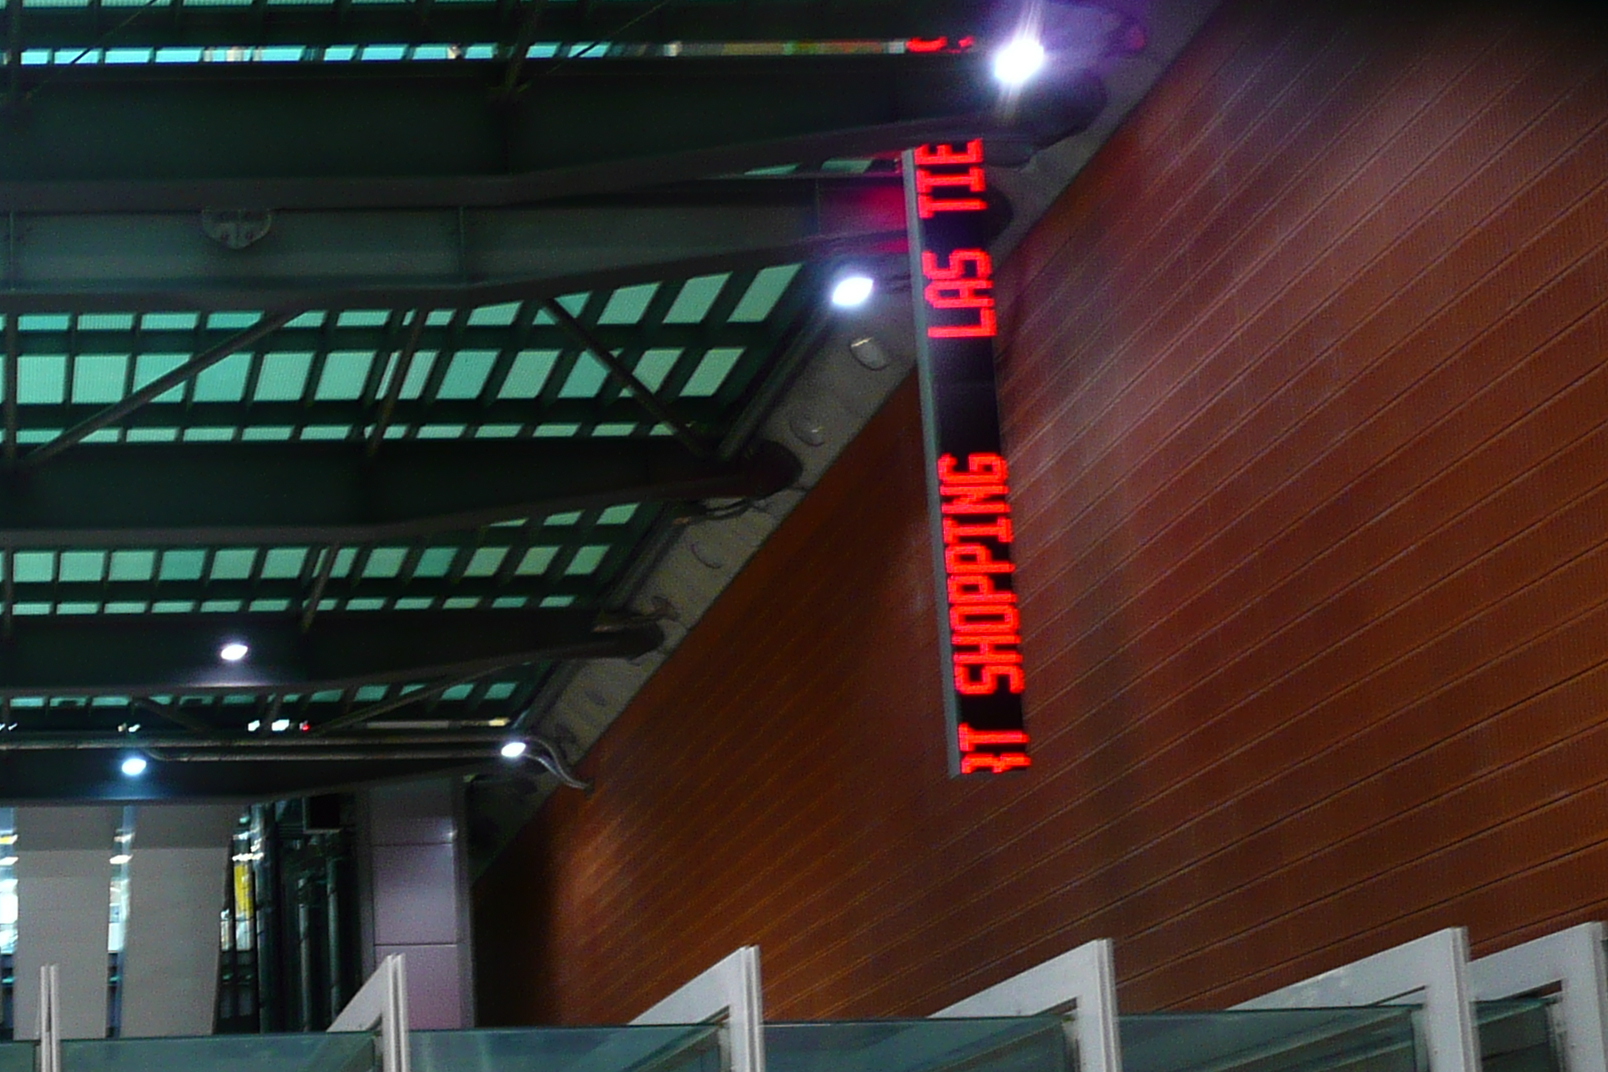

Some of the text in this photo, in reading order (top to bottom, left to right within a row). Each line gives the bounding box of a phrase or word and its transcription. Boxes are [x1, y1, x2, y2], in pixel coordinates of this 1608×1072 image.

[914, 138, 986, 219] TIE
[922, 249, 998, 339] LAS
[938, 453, 1025, 695] SHOPPING
